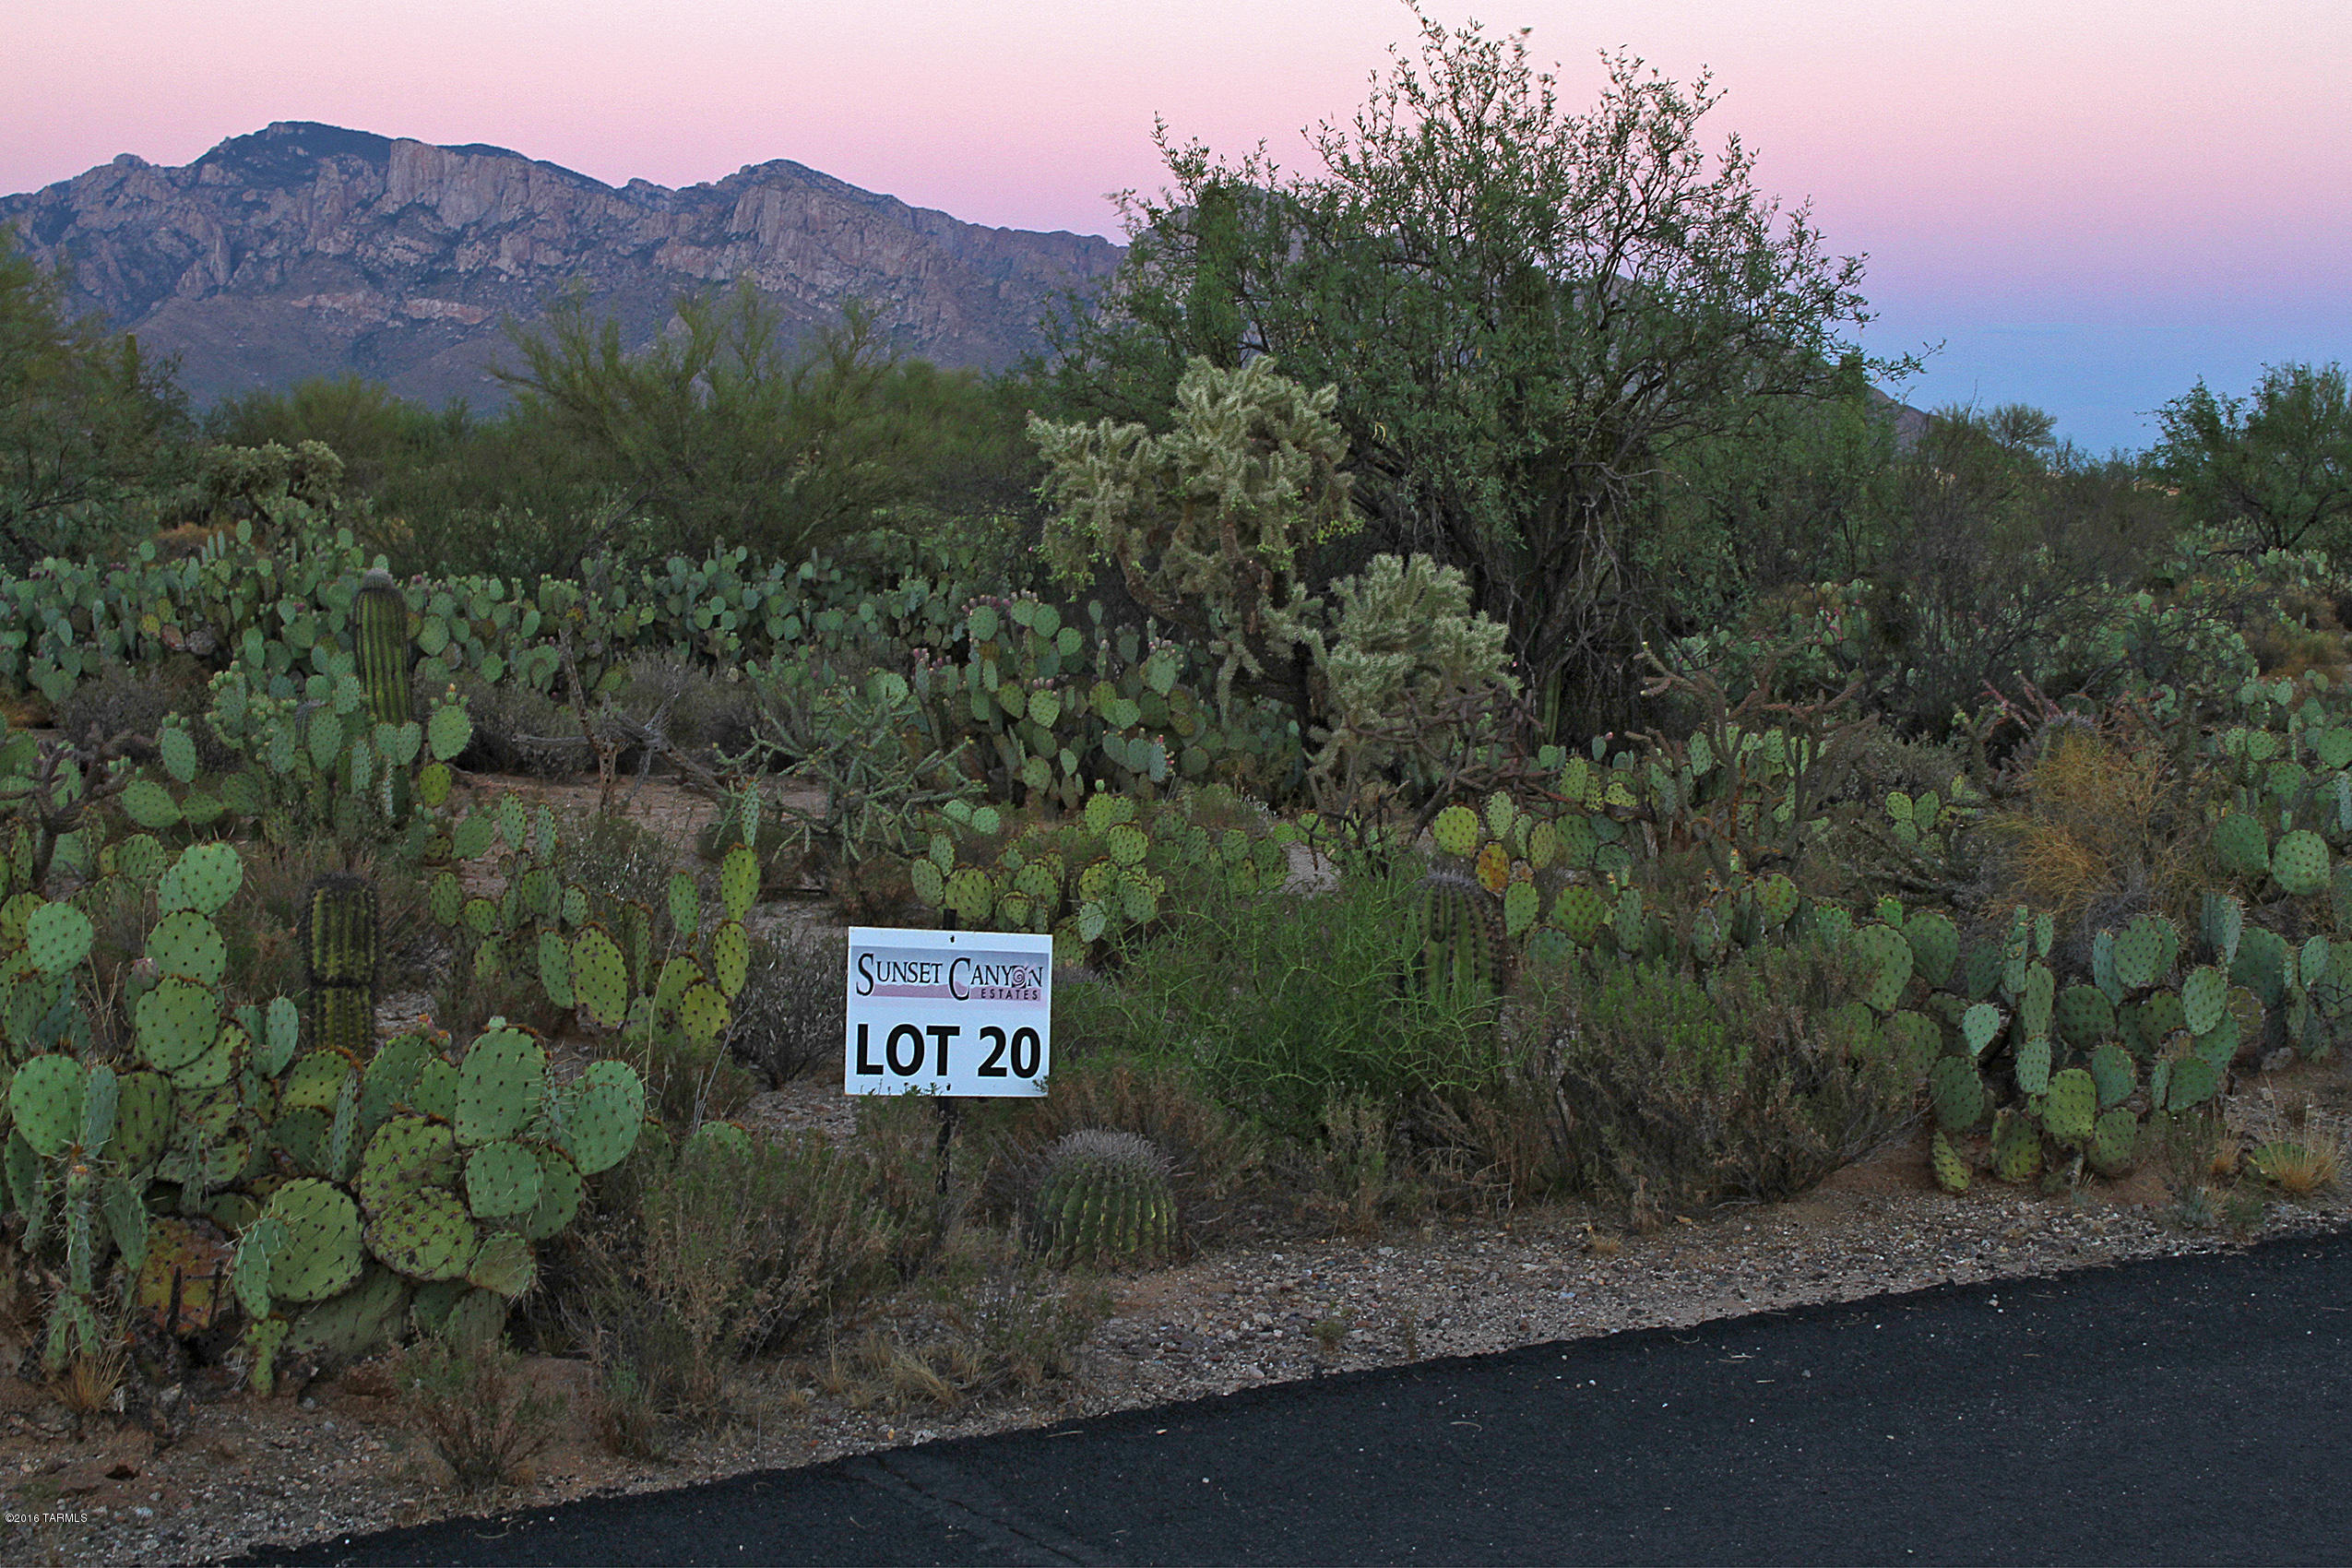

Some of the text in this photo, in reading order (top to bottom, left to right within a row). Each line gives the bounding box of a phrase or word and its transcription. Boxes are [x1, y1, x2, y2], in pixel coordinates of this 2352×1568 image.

[856, 953, 1043, 1001] SUNSET CANYON
[980, 988, 1039, 1001] ESTATES
[856, 1023, 1041, 1078] LOT 20
